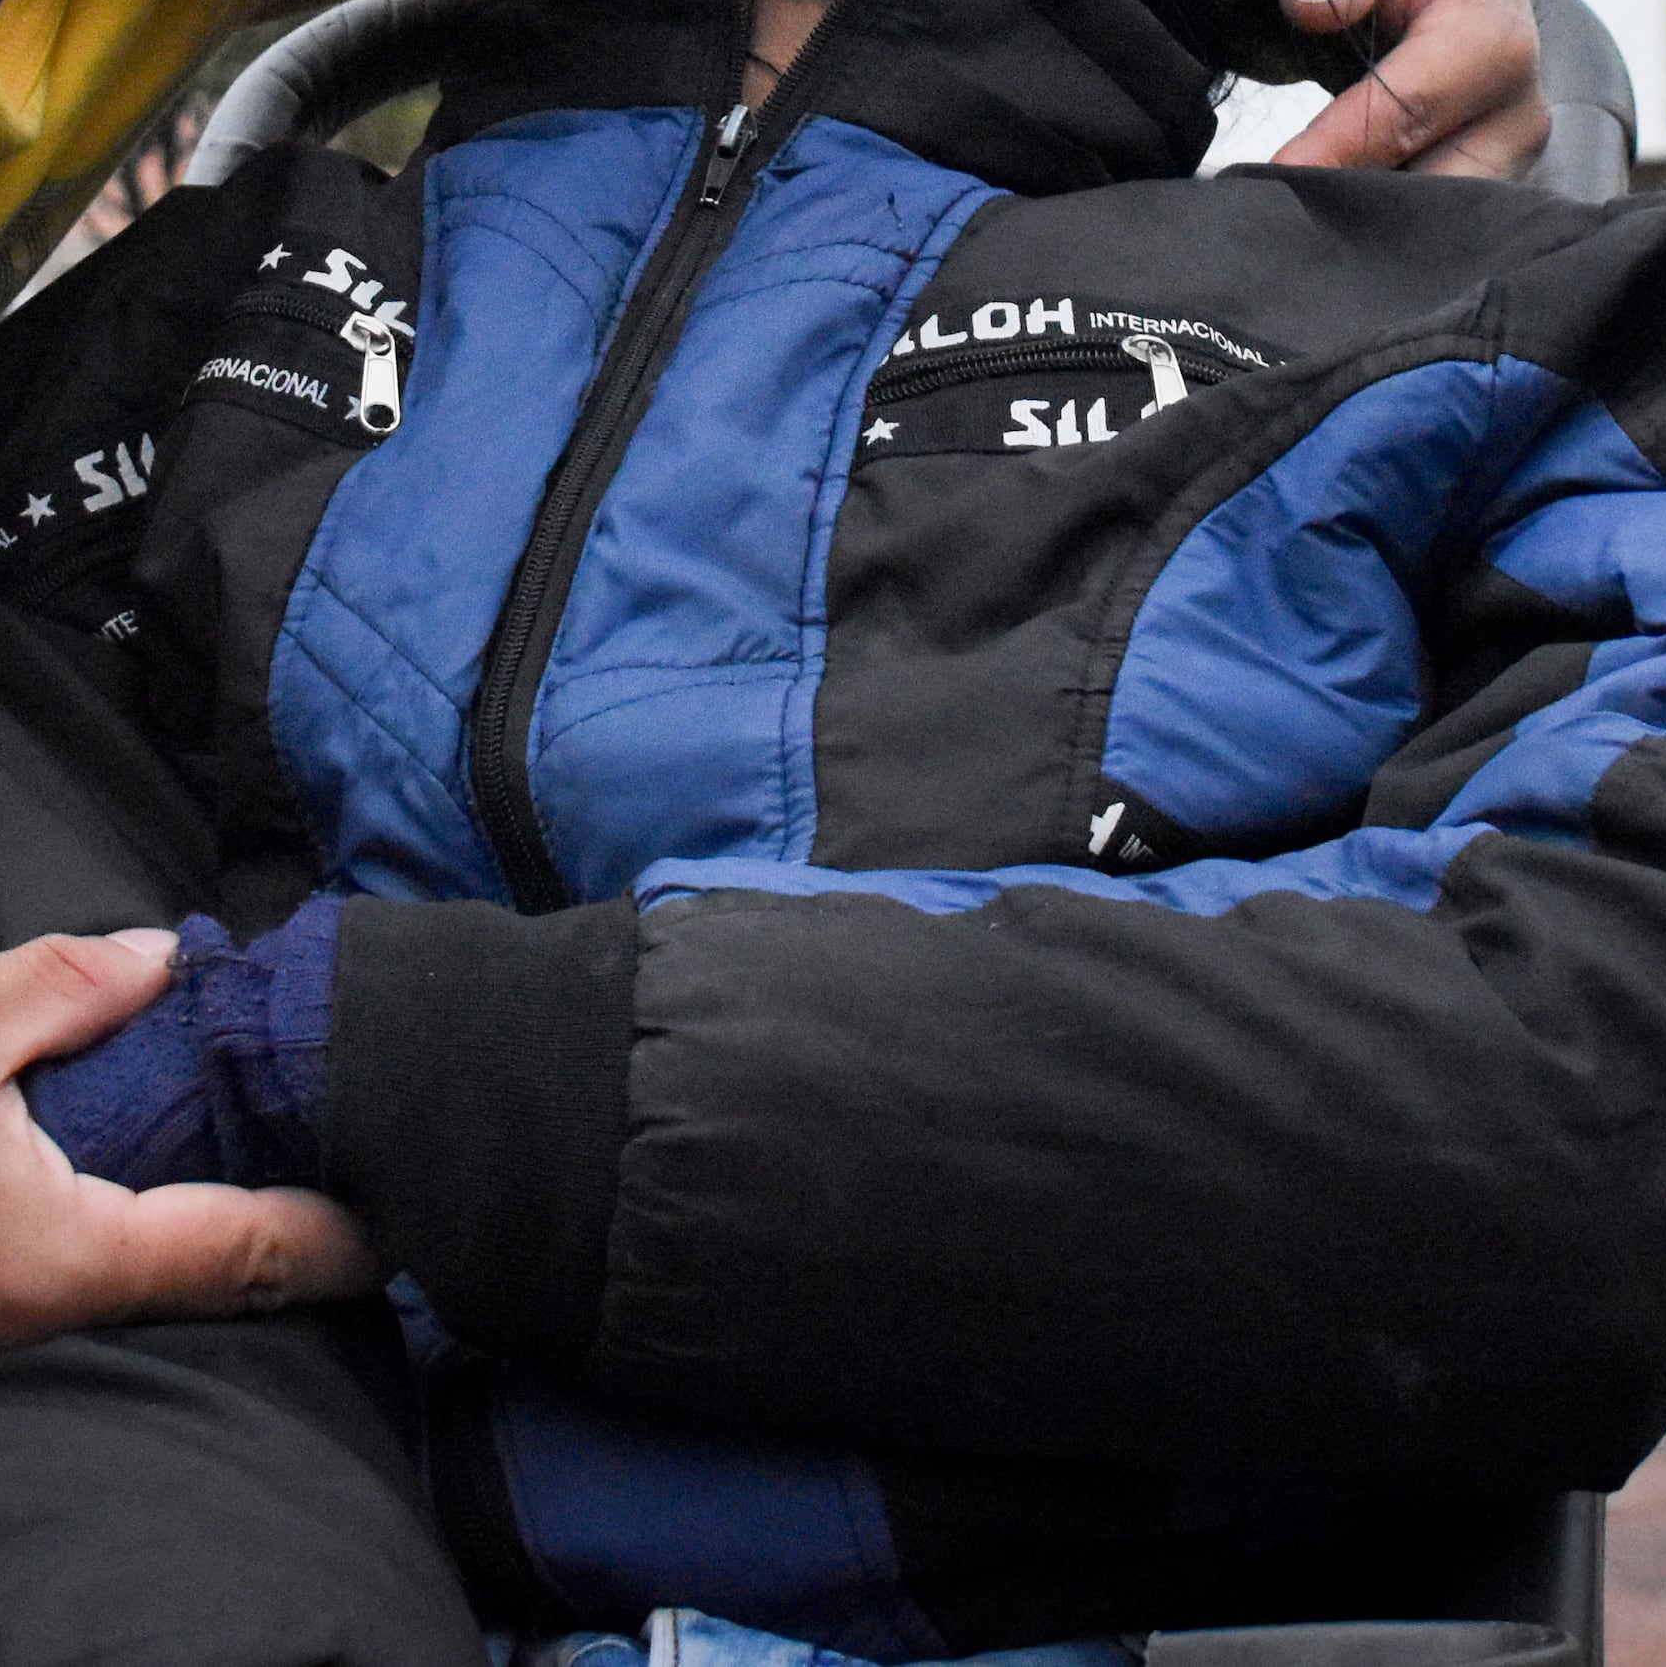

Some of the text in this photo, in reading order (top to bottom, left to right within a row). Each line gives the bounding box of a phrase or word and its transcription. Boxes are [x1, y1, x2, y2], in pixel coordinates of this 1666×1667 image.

[878, 297, 1270, 368] ILOH INTERNACIONAL
[1002, 396, 1158, 447] SIL
